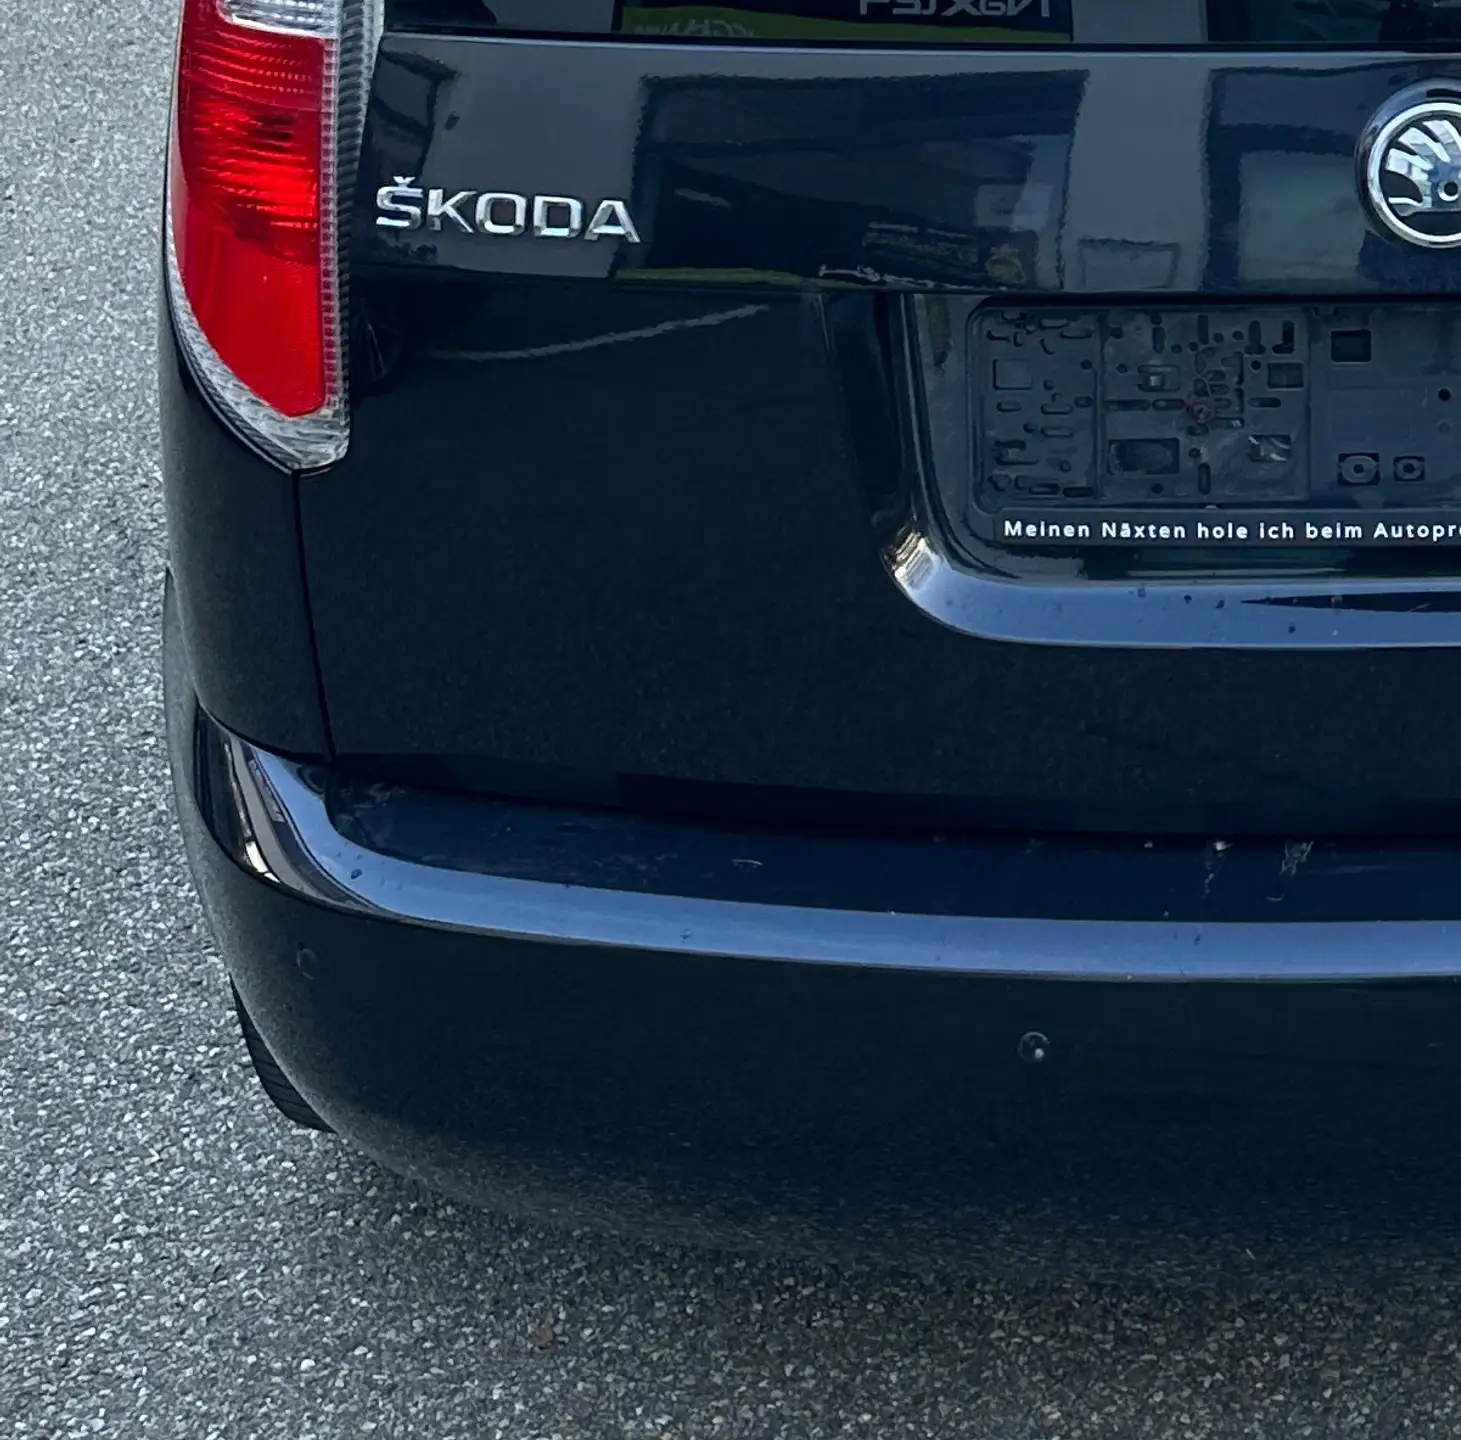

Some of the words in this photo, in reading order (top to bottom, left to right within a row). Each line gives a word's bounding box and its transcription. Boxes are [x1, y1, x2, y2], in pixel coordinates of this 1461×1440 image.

[375, 176, 641, 243] ŠKODA
[1004, 520, 1090, 538] Meinen
[1102, 521, 1185, 539] Näxten
[1198, 521, 1248, 539] hole
[1259, 520, 1294, 539] ich
[1305, 520, 1362, 539] beim
